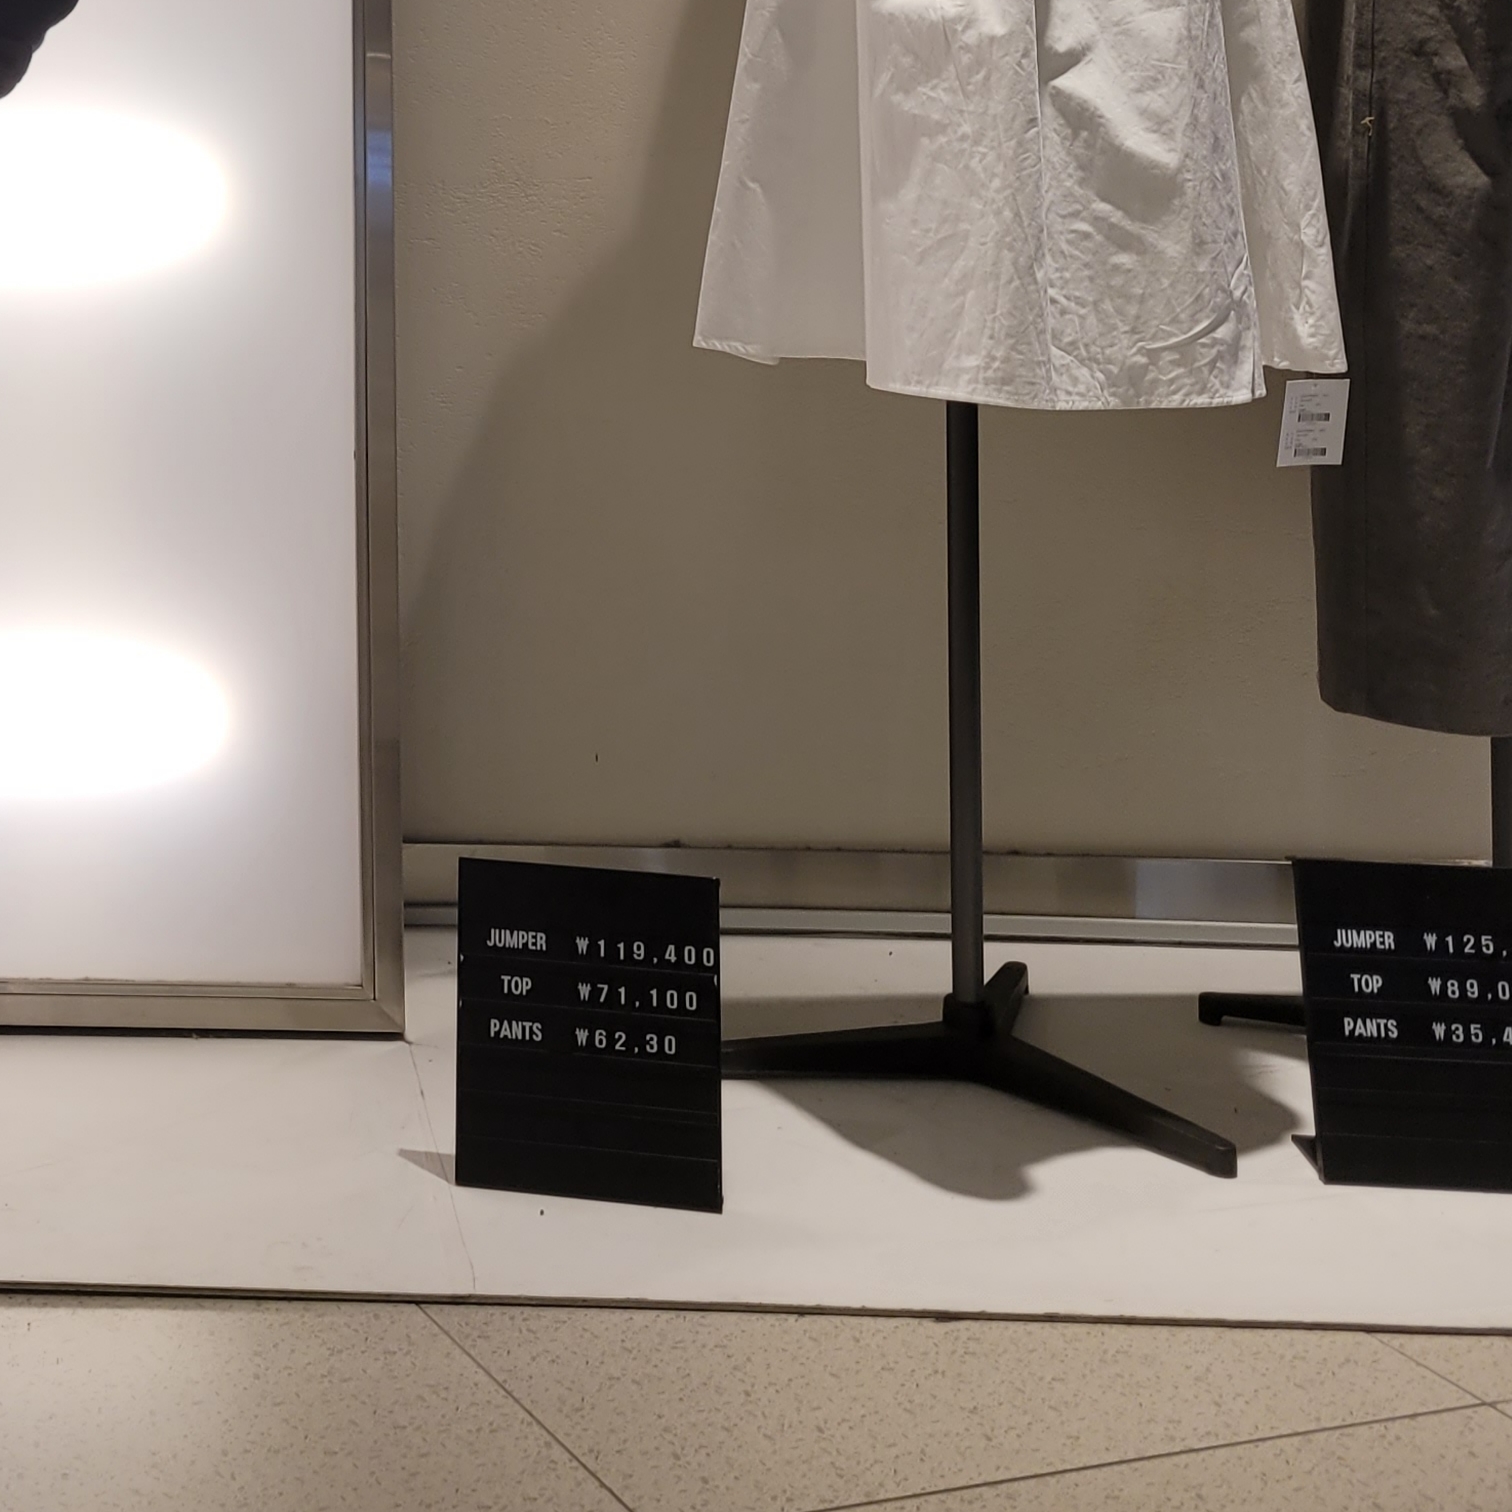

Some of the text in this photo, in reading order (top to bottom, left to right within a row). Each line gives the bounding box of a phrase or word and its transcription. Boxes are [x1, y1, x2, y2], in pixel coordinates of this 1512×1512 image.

[486, 928, 547, 951] JUMPER
[1333, 928, 1395, 950] JUMPER
[500, 975, 532, 996] TOP
[1350, 973, 1383, 994] TOP
[490, 1018, 543, 1042] PANTS
[1343, 1017, 1399, 1039] PANTS
